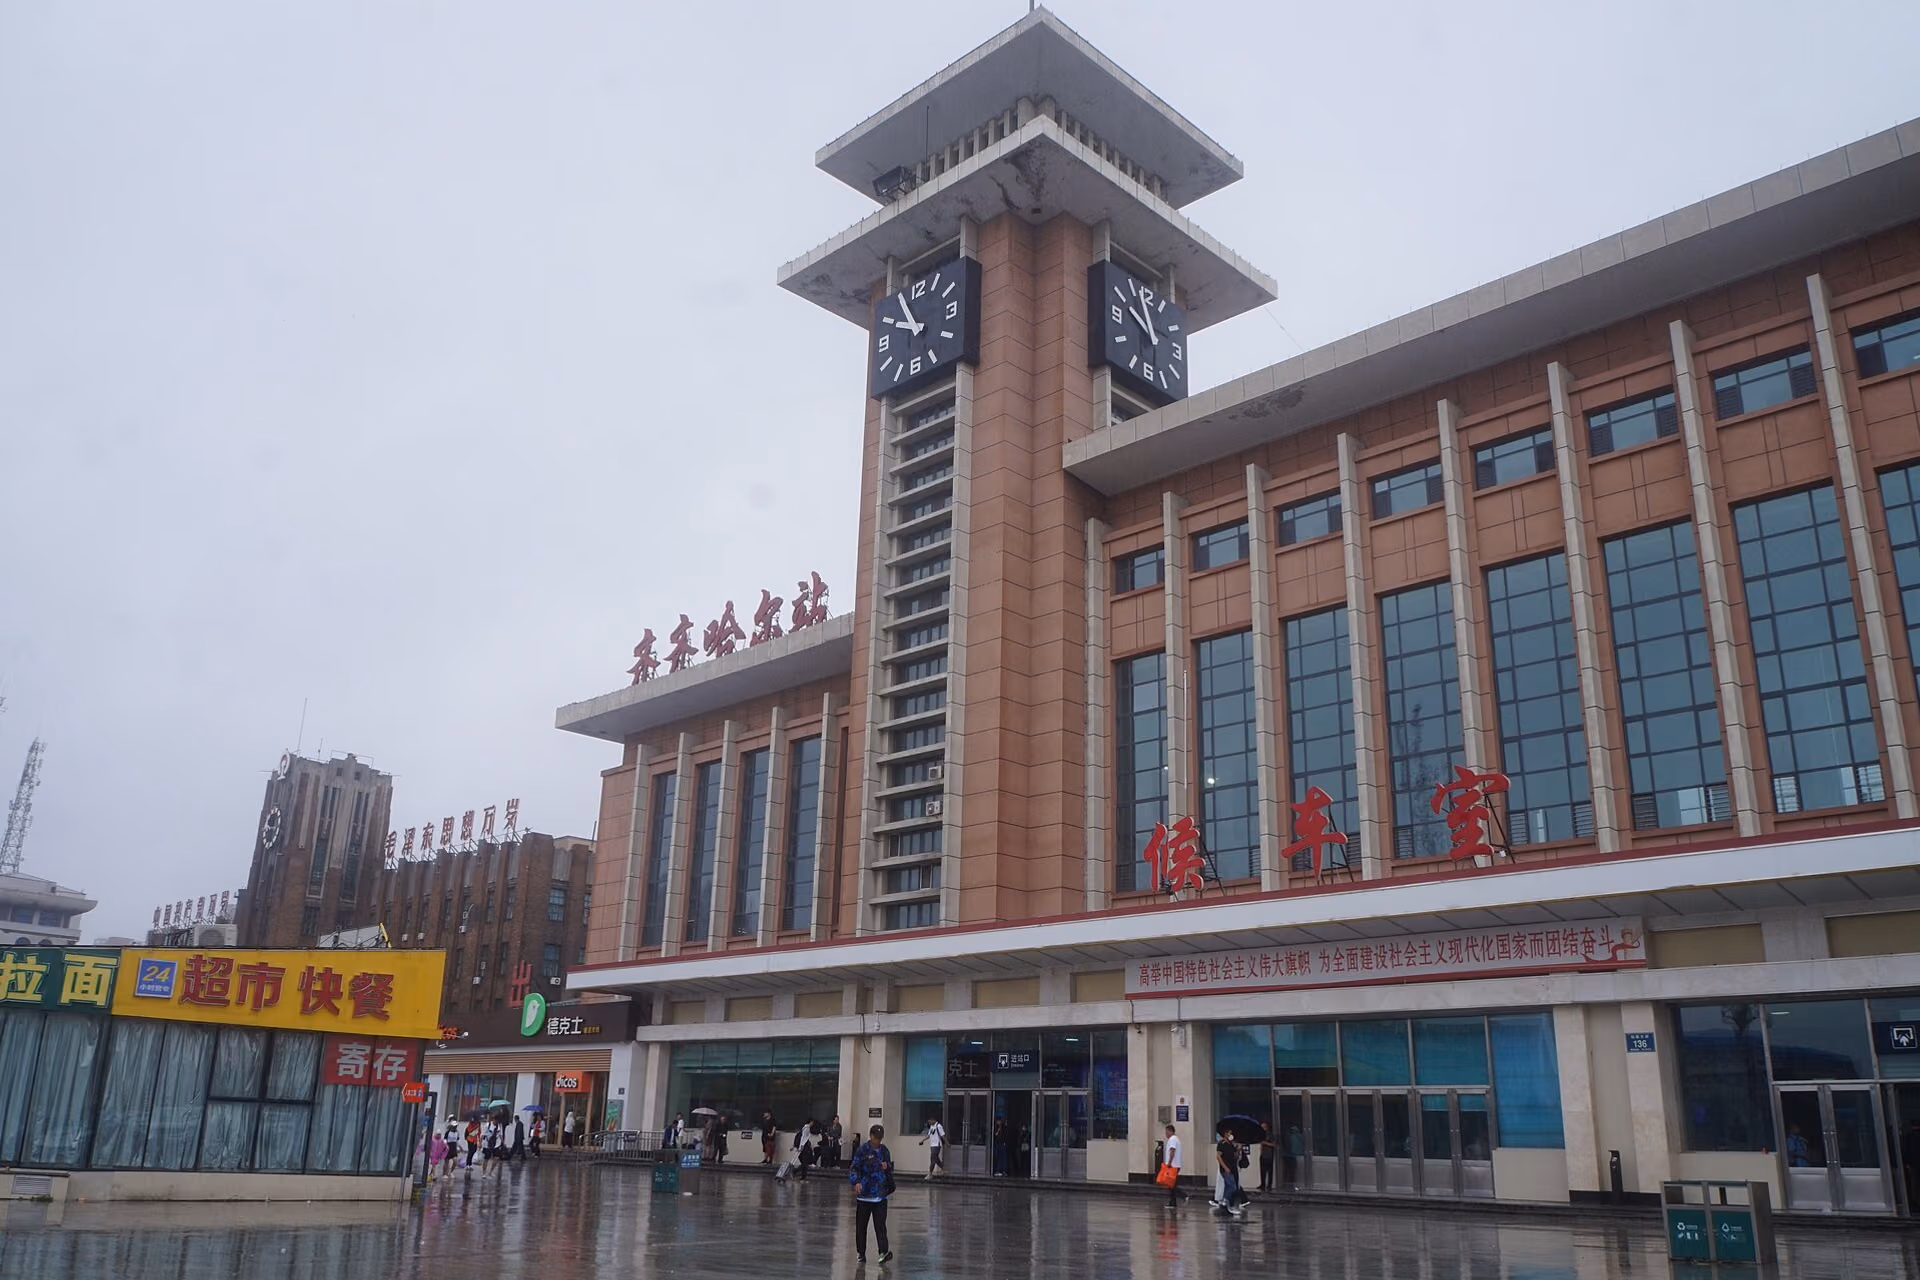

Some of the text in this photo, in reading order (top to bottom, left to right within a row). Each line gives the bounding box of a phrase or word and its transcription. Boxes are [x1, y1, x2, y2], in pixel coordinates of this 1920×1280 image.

[911, 279, 927, 301] 12
[945, 300, 958, 321] 3
[1111, 304, 1123, 324] 9
[878, 334, 890, 353] 9
[1172, 342, 1182, 361] 3
[910, 356, 921, 376] 6
[1143, 362, 1154, 382] 6
[626, 570, 829, 686] 齐齐哈尔站
[384, 798, 520, 858] 毛泽东思想万岁
[1143, 764, 1511, 893] 候车室
[1139, 924, 1615, 986] 高举中国特色社会主义伟大旗帜 为全面建设社会主义现代化国家而团结奋斗
[0, 952, 119, 1008] 拉面
[142, 965, 172, 983] 24
[547, 1016, 583, 1035] 德克士
[1633, 1039, 1648, 1048] 136
[336, 1042, 408, 1080] 寄存
[1010, 1054, 1030, 1063] 进站口
[555, 1075, 577, 1088] dicos
